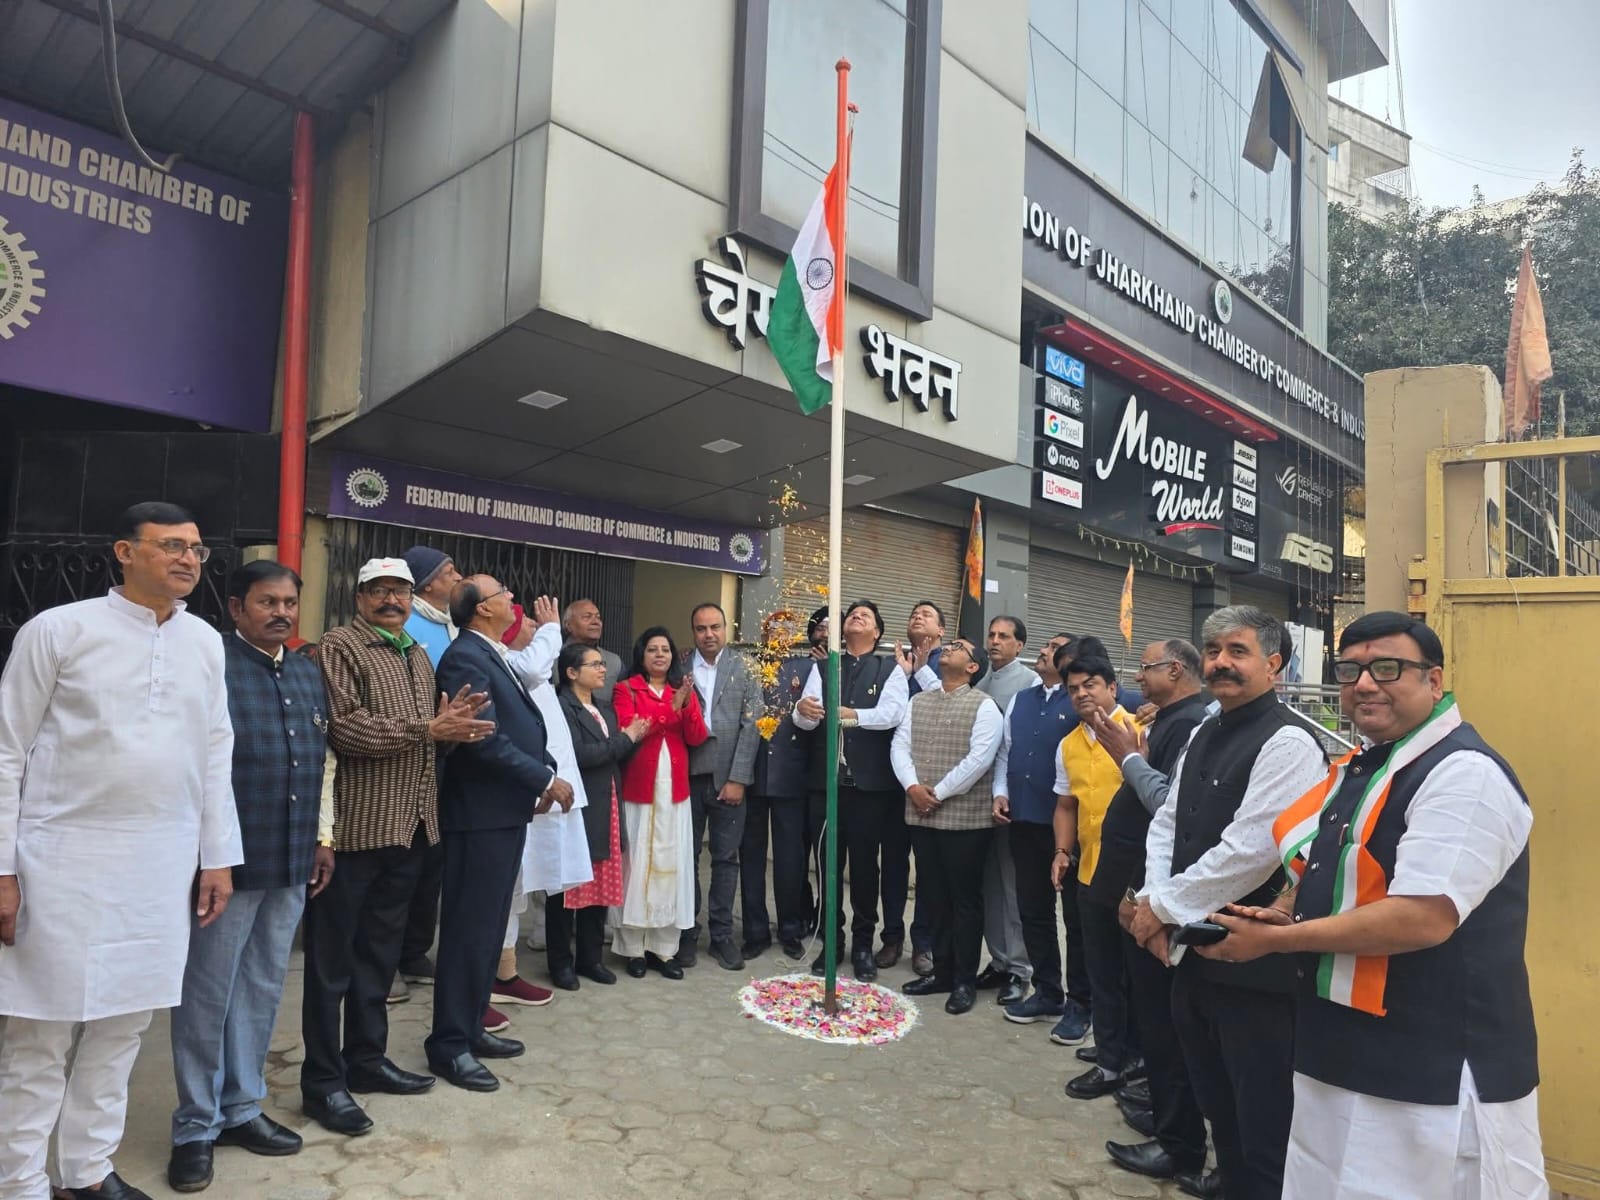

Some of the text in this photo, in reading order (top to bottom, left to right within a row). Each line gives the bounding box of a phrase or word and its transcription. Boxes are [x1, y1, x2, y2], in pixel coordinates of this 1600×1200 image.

[78, 147, 214, 216] CHAMBER
[219, 195, 251, 226] OF
[1065, 226, 1092, 267] OF
[1096, 248, 1195, 334] JHARKHAND
[1198, 314, 1258, 375] CHAMBER
[1259, 354, 1274, 382] OF
[1275, 364, 1330, 420] COMMERCE
[1332, 401, 1339, 424] &
[860, 324, 963, 422] भवन
[1050, 354, 1081, 382] vivo
[1050, 383, 1080, 410] iPhone
[1060, 420, 1080, 440] Pixel
[1059, 454, 1080, 470] moto
[1054, 485, 1080, 499] ONEPLUS
[1151, 479, 1225, 522] World
[1236, 492, 1254, 510] dyson
[406, 484, 475, 514] FEDERATION
[477, 496, 491, 517] OF
[492, 500, 554, 527] JHARKHAND
[555, 509, 602, 535] CHAMBER
[603, 518, 616, 536] OF
[616, 519, 666, 544] COMMERCE
[666, 531, 673, 545] &
[674, 529, 721, 553] INDUSTRIES
[1233, 541, 1255, 556] SAMSUNG
